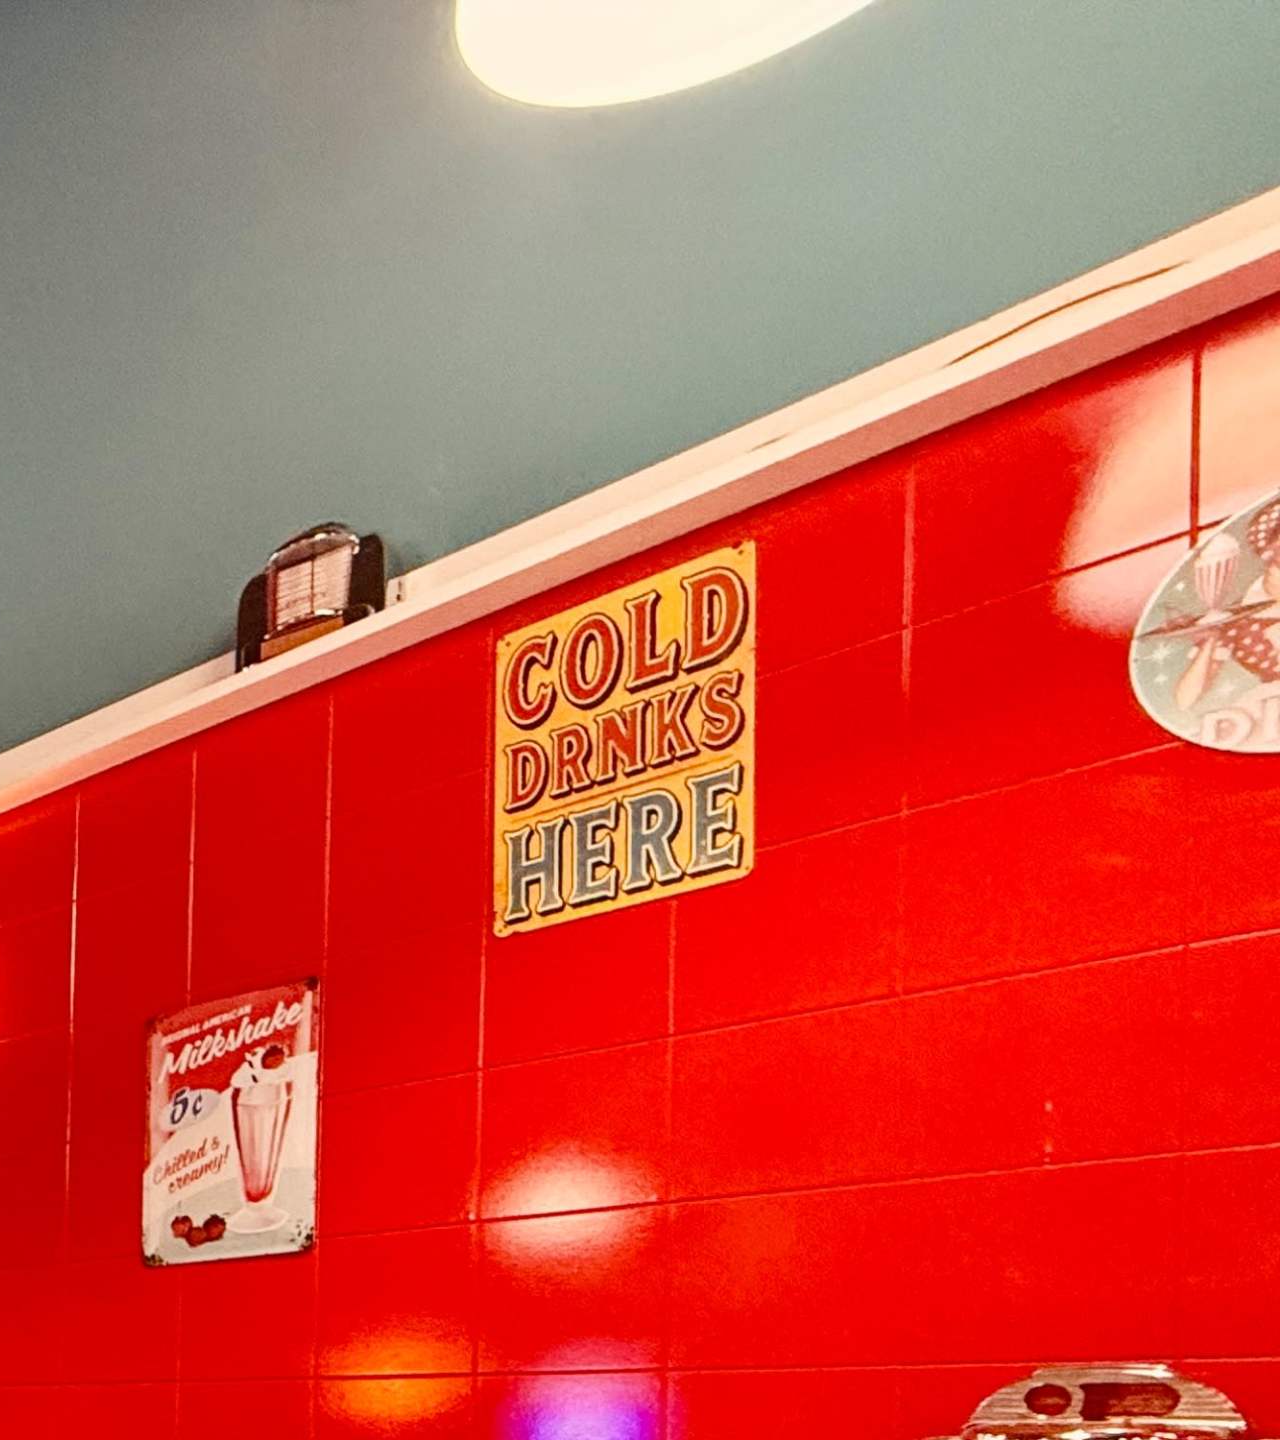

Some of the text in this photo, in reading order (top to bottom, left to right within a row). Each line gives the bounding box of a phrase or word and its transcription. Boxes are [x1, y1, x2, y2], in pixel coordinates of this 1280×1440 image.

[504, 566, 750, 730] COLD
[504, 669, 745, 812] DRNKS
[504, 762, 743, 924] HERE
[157, 1001, 303, 1084] Milkshake
